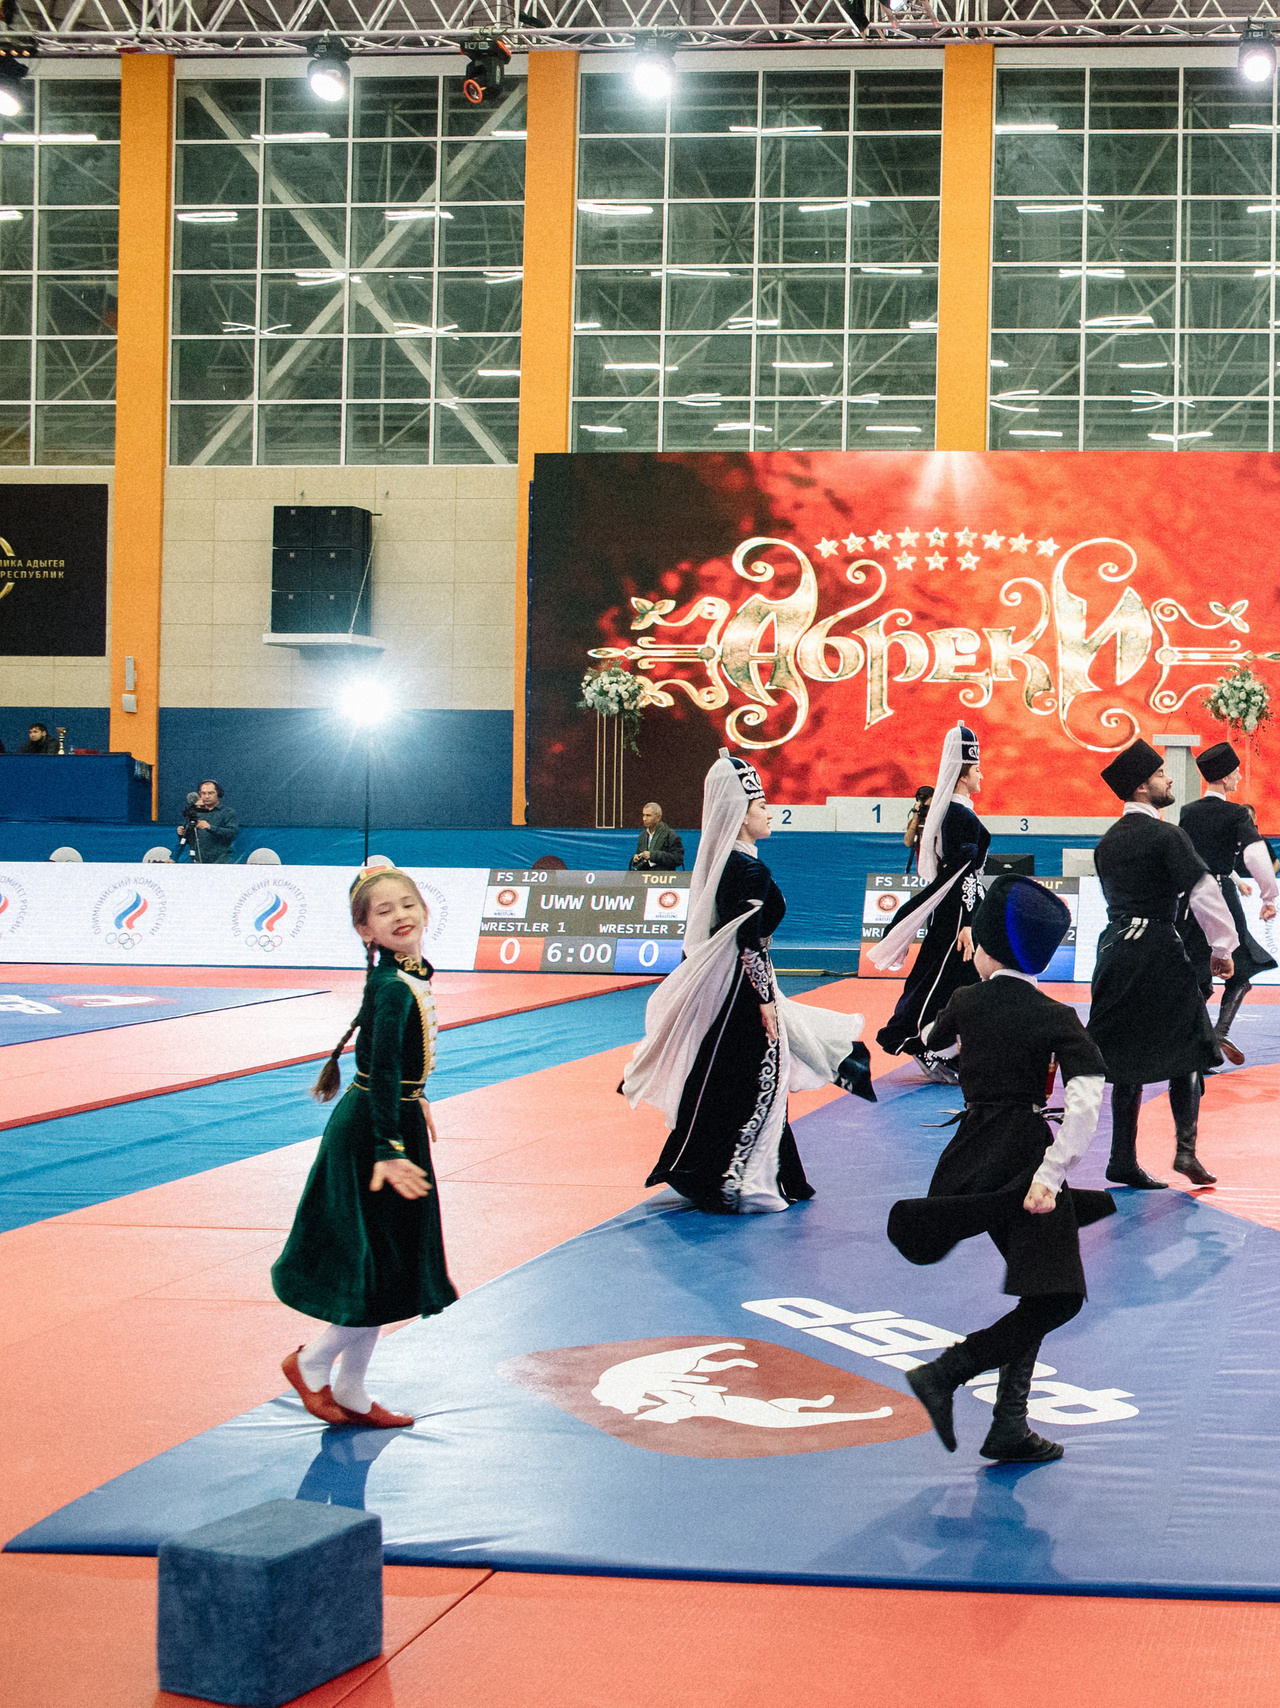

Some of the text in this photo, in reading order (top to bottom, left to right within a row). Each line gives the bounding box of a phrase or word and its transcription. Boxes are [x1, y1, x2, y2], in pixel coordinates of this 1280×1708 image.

[26, 559, 65, 568] АДЫГЕЯ
[0, 570, 65, 578] РЕСПУБЛИК
[781, 809, 792, 825] 2
[871, 804, 882, 824] 1
[1019, 818, 1029, 832] 3
[496, 871, 548, 883] FS 120
[585, 872, 596, 885] 0
[642, 873, 677, 885] Tour
[875, 876, 928, 888] FS 120
[0, 875, 27, 897] ОМИТЕТ
[133, 876, 166, 900] КОМИТЕТ
[272, 879, 306, 902] КОМИТЕТ
[289, 903, 307, 938] РОССИИ
[540, 894, 635, 911] UWW UWW
[416, 881, 449, 941] ОМИТЕТ РОССИИ
[481, 921, 566, 933] WRESTLER 1
[599, 923, 686, 935] WRESTLER 2
[499, 937, 521, 965] 0
[547, 941, 612, 964] 6:00
[638, 940, 660, 967] 0
